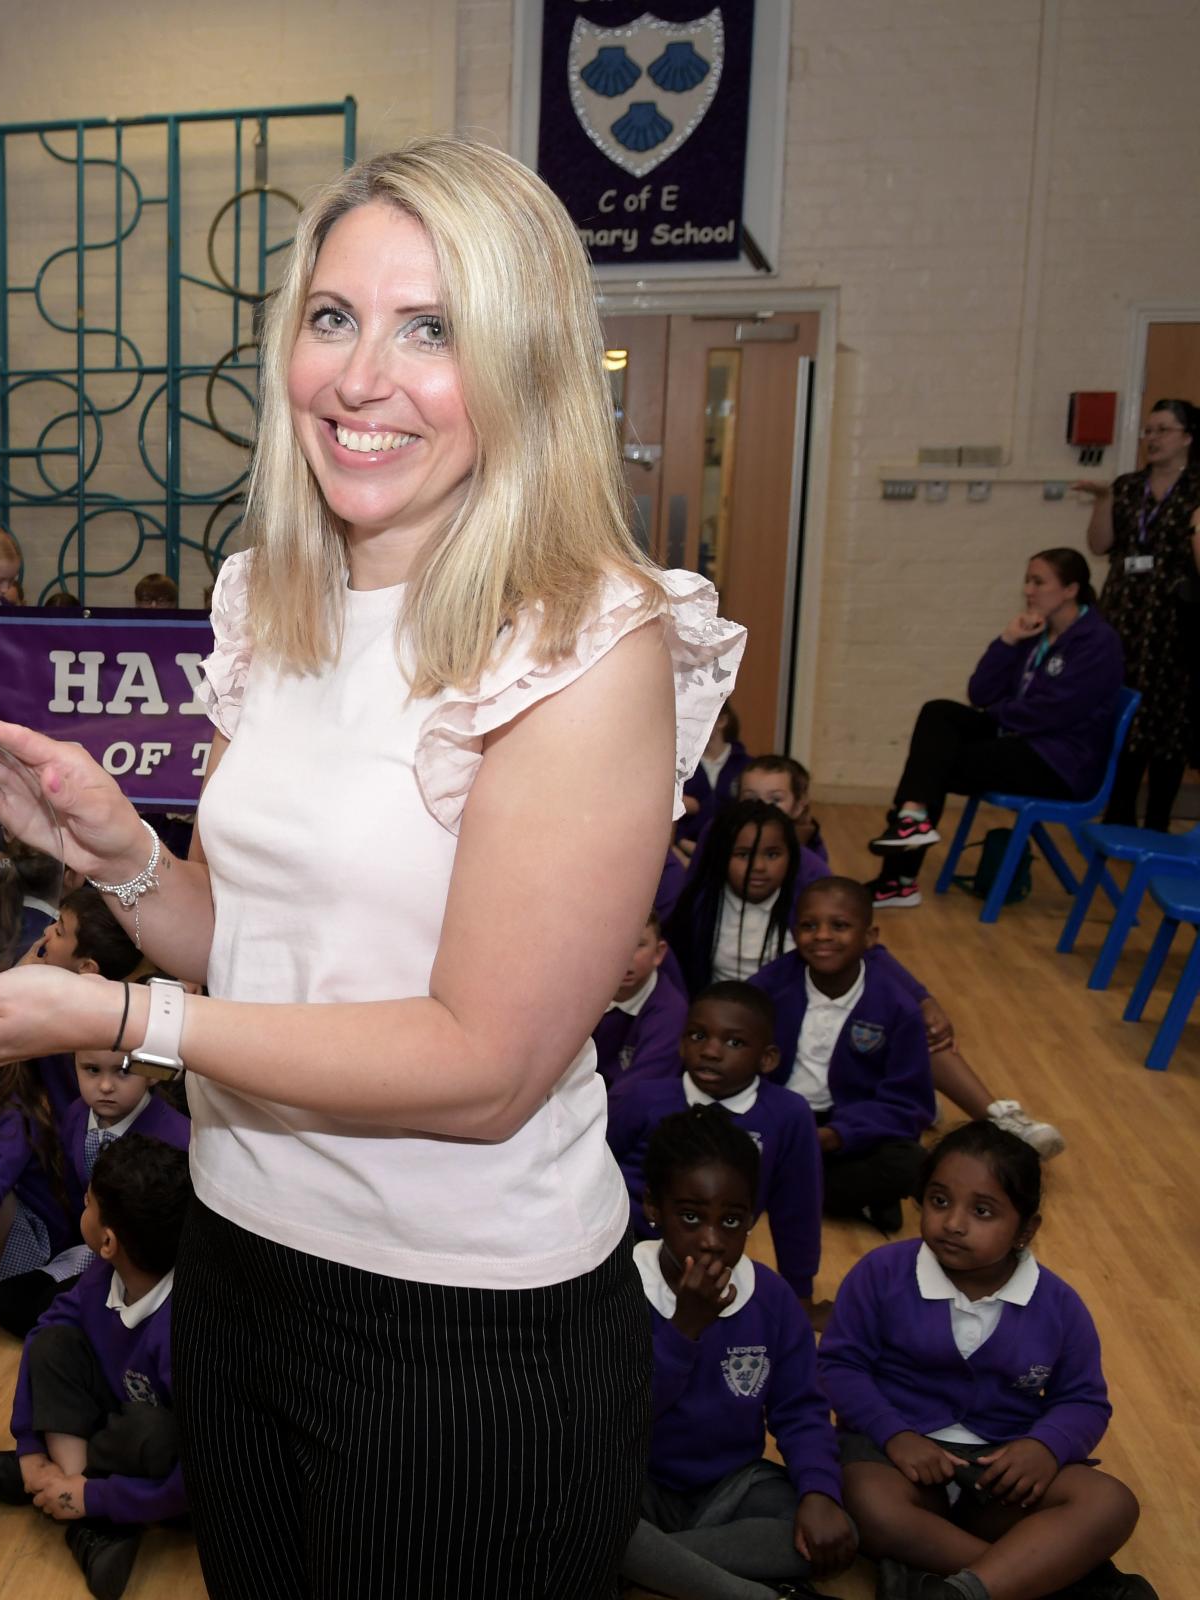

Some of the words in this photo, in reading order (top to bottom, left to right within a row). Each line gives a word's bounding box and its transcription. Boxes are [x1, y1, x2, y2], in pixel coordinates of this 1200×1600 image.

[598, 189, 617, 213] C
[623, 185, 651, 212] of
[660, 185, 679, 211] E
[578, 228, 638, 252] mary
[650, 220, 735, 246] School
[103, 741, 171, 776] OF
